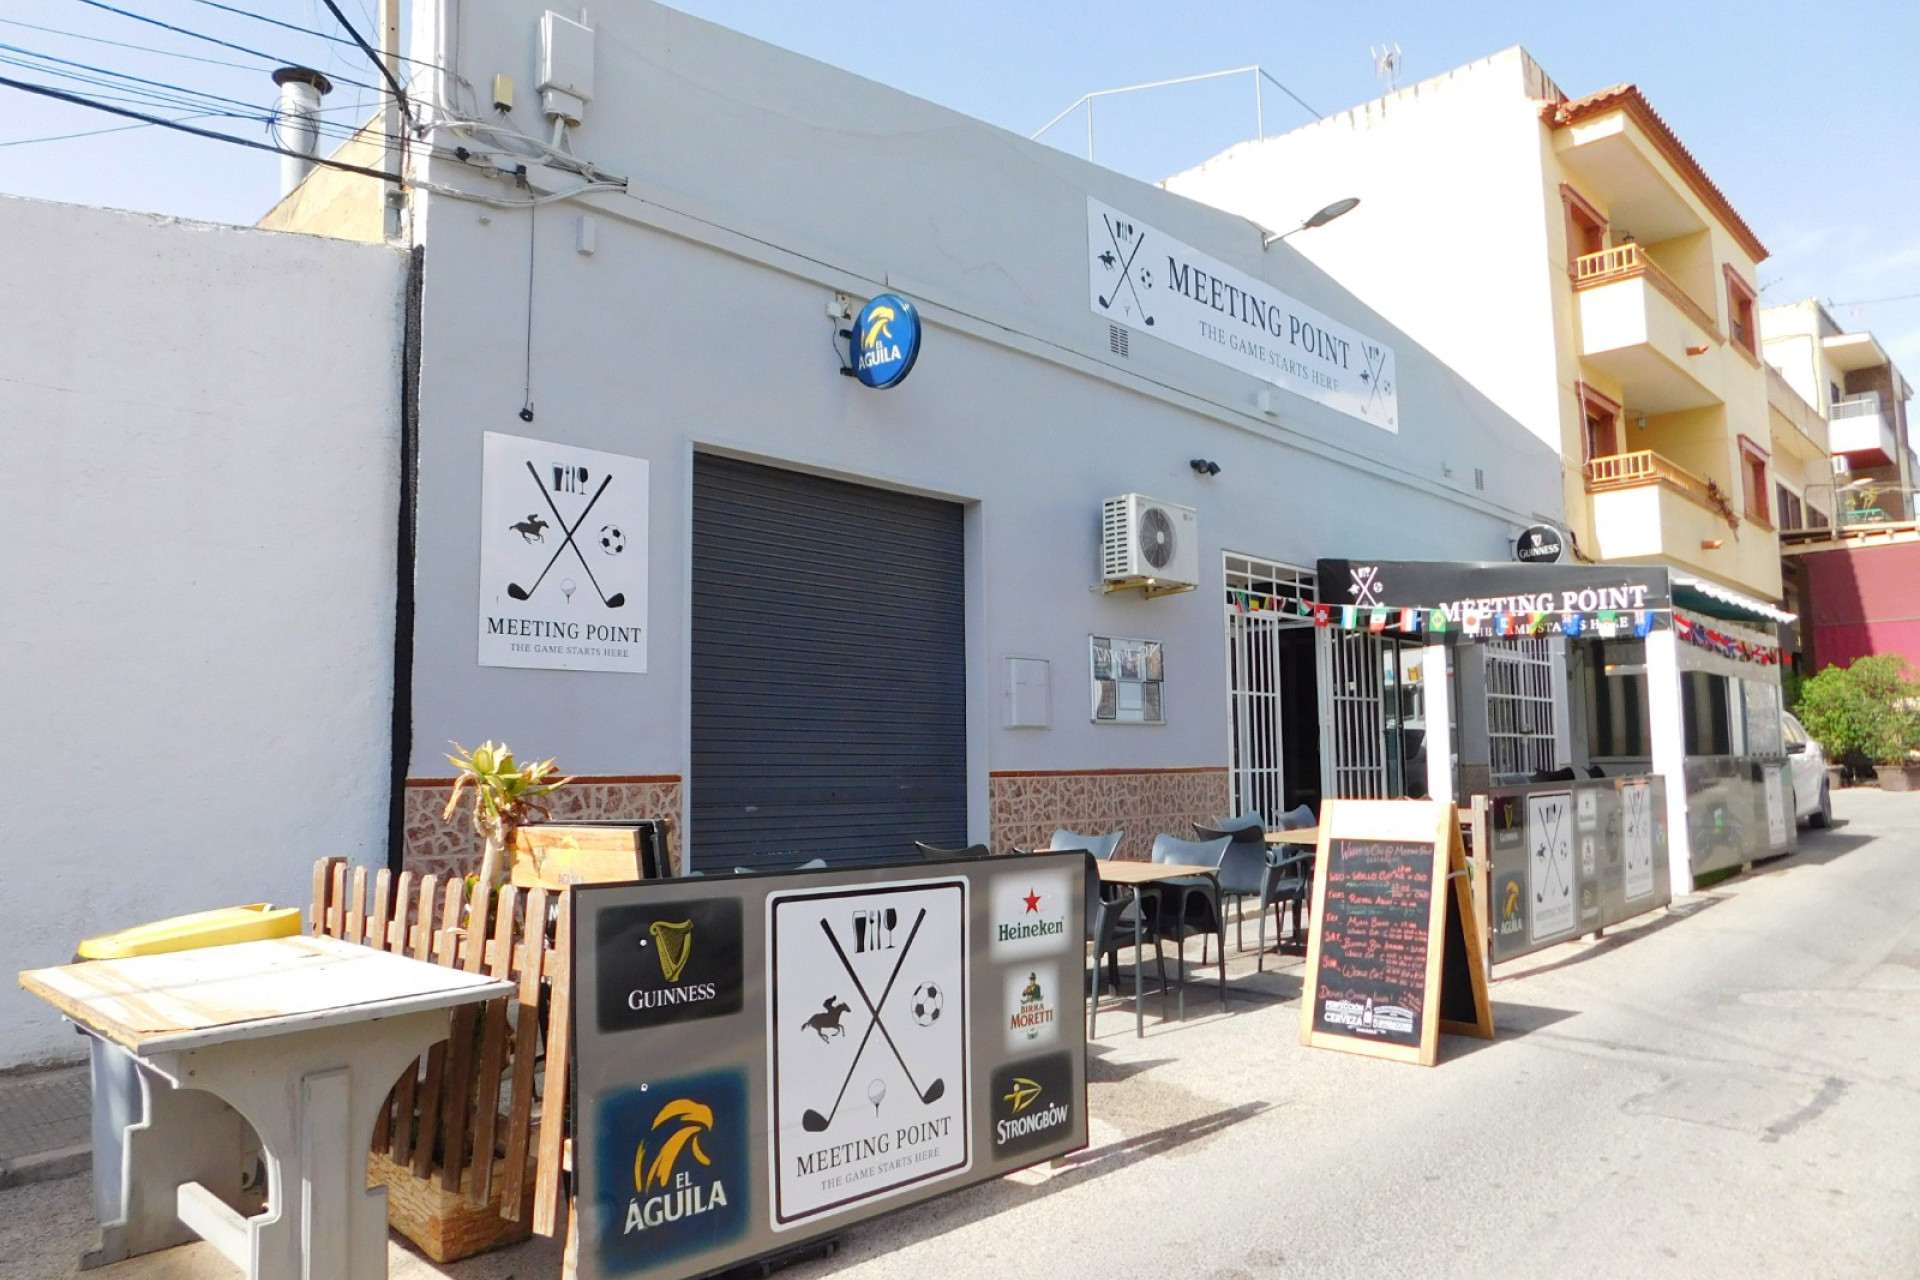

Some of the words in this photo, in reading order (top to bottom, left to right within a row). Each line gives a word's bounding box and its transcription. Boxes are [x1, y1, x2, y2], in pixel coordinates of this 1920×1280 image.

[1167, 255, 1283, 337] MEETING
[1289, 314, 1350, 369] POINT
[1199, 320, 1226, 345] THE
[1229, 334, 1267, 361] GAME
[1269, 351, 1309, 381] STARTS
[1311, 370, 1339, 393] HERE
[1519, 543, 1560, 559] GUINNESS
[1439, 592, 1554, 622] MEETING
[1561, 585, 1648, 612] POINT
[487, 617, 579, 640] MEETING
[586, 624, 642, 643] POINT
[510, 643, 531, 653] THE
[533, 644, 564, 654] GAME
[566, 646, 601, 656] STARTS
[603, 647, 629, 658] HERE
[998, 919, 1063, 941] Heineken
[628, 982, 716, 1010] GUINNESS
[1020, 1002, 1045, 1014] BIRRA
[1010, 1010, 1053, 1030] MORETTI
[997, 1104, 1068, 1145] STRONGBOW
[797, 1133, 890, 1177] MEETING
[896, 1116, 951, 1149] POINT
[676, 1171, 692, 1189] EL
[821, 1175, 842, 1192] THE
[845, 1167, 875, 1184] GAME
[878, 1154, 912, 1174] STARTS
[915, 1147, 940, 1163] HERE
[624, 1180, 728, 1235] ÁGUILA
